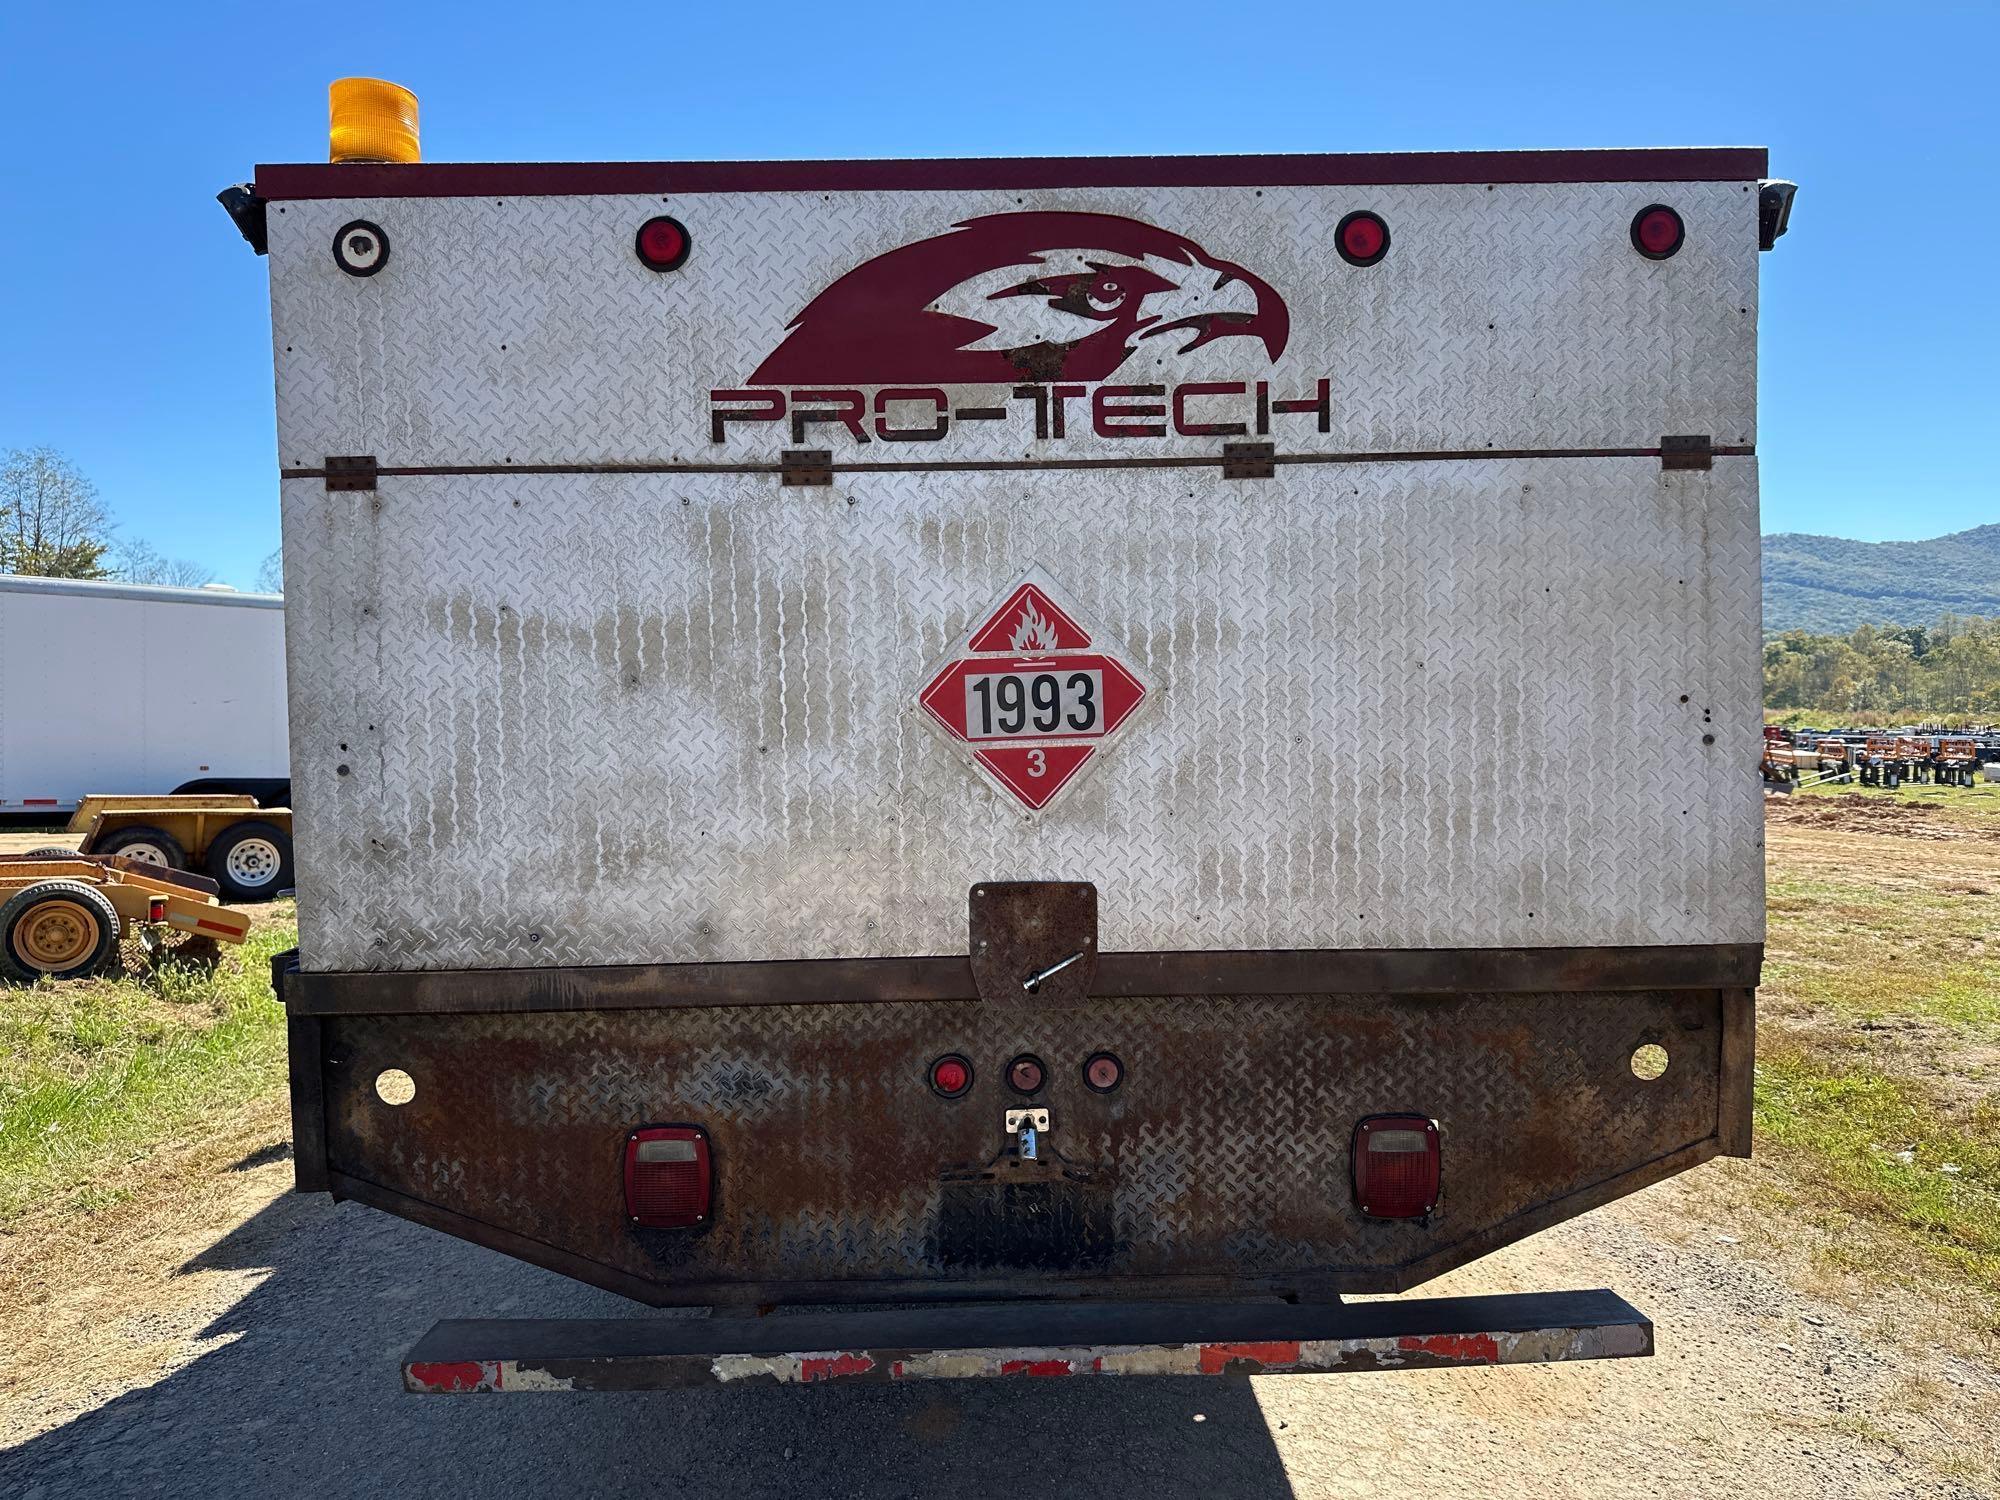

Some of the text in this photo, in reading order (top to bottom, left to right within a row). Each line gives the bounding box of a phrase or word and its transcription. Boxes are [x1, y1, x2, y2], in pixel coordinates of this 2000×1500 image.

[711, 379, 1331, 444] PRO-TECH
[973, 673, 1096, 734] 1993
[1027, 749, 1047, 777] 3
